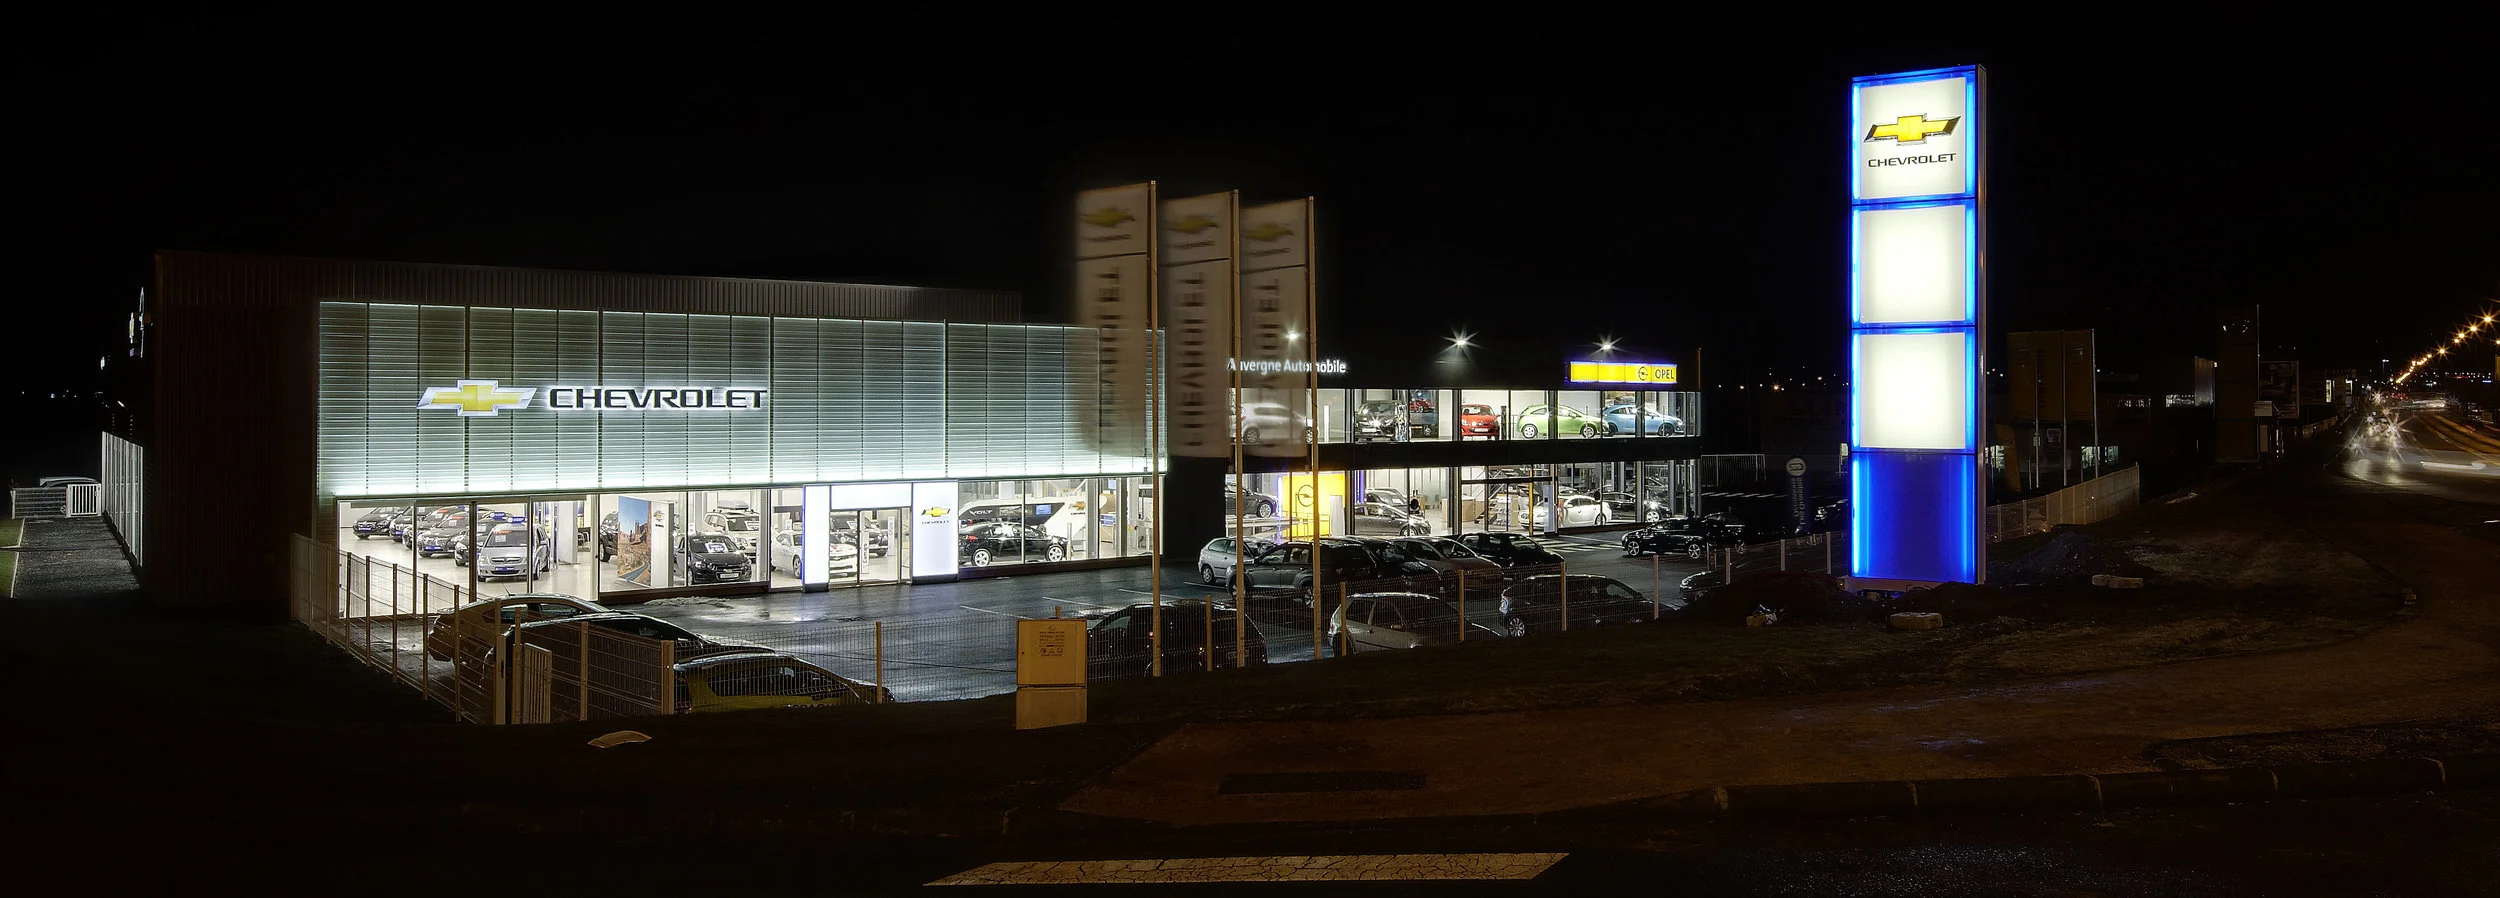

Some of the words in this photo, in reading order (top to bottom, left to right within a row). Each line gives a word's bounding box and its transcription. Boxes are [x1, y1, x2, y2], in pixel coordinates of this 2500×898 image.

[1868, 153, 1957, 168] CHEVROLET
[1654, 369, 1675, 379] OPEL
[549, 388, 768, 409] CHEVROLET
